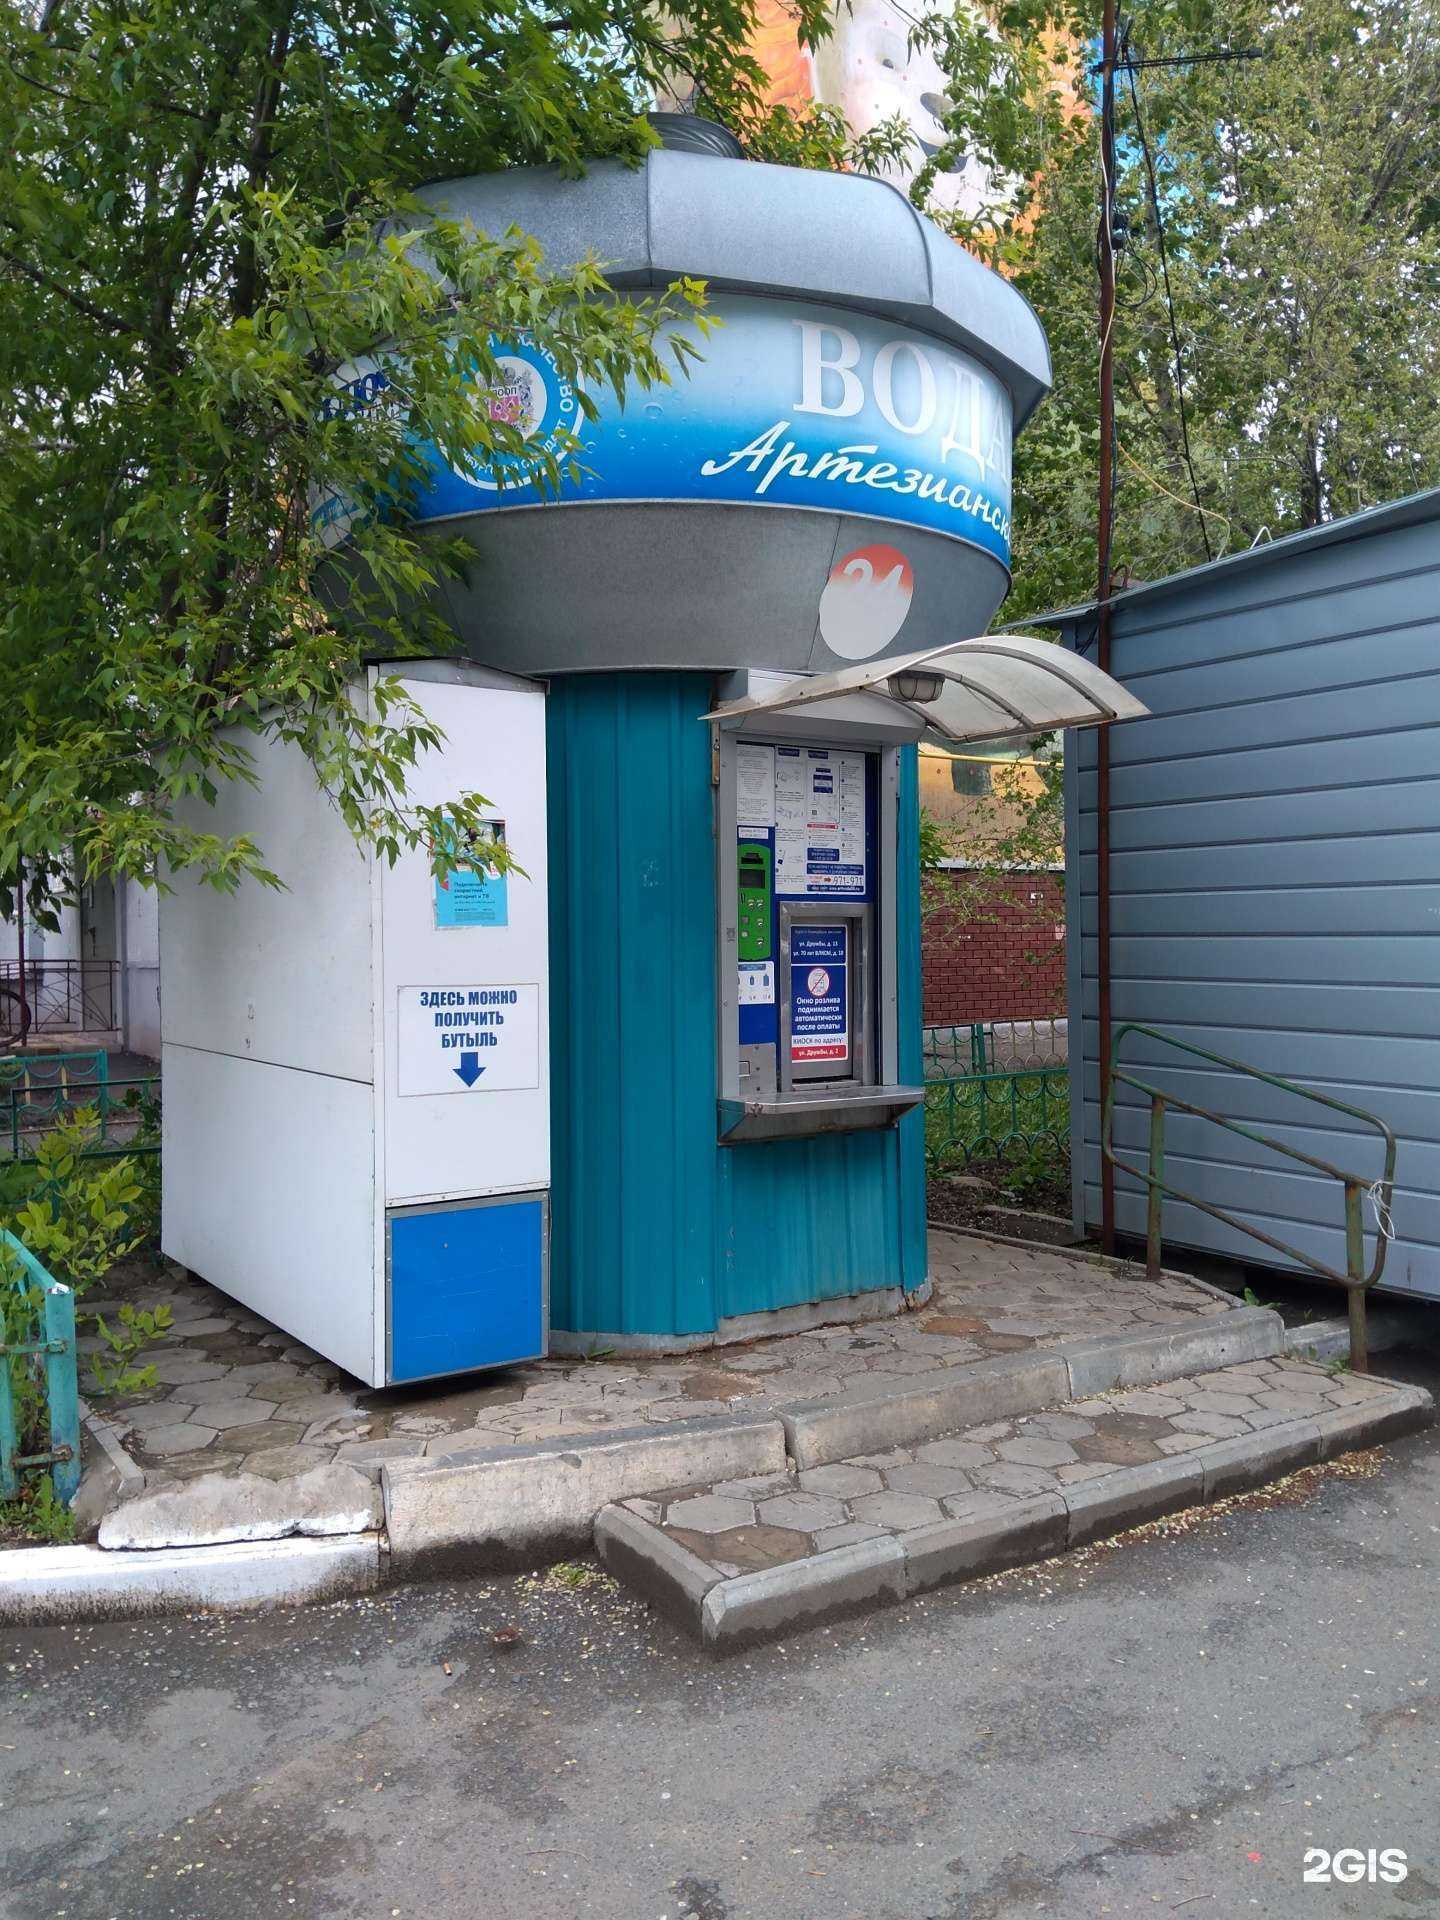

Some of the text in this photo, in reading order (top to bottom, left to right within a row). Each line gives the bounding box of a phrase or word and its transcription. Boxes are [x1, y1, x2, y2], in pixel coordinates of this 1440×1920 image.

[792, 318, 1011, 488] ВОДА
[700, 420, 1011, 545] Артезианск
[420, 990, 517, 1008] ЗДЕСЬ МОЖНО
[814, 997, 841, 1005] розлива
[797, 1006, 840, 1014] поднимается
[434, 1011, 504, 1027] ПОЛУЧИТЬ
[441, 1032, 498, 1048] БУТЫЛЬ
